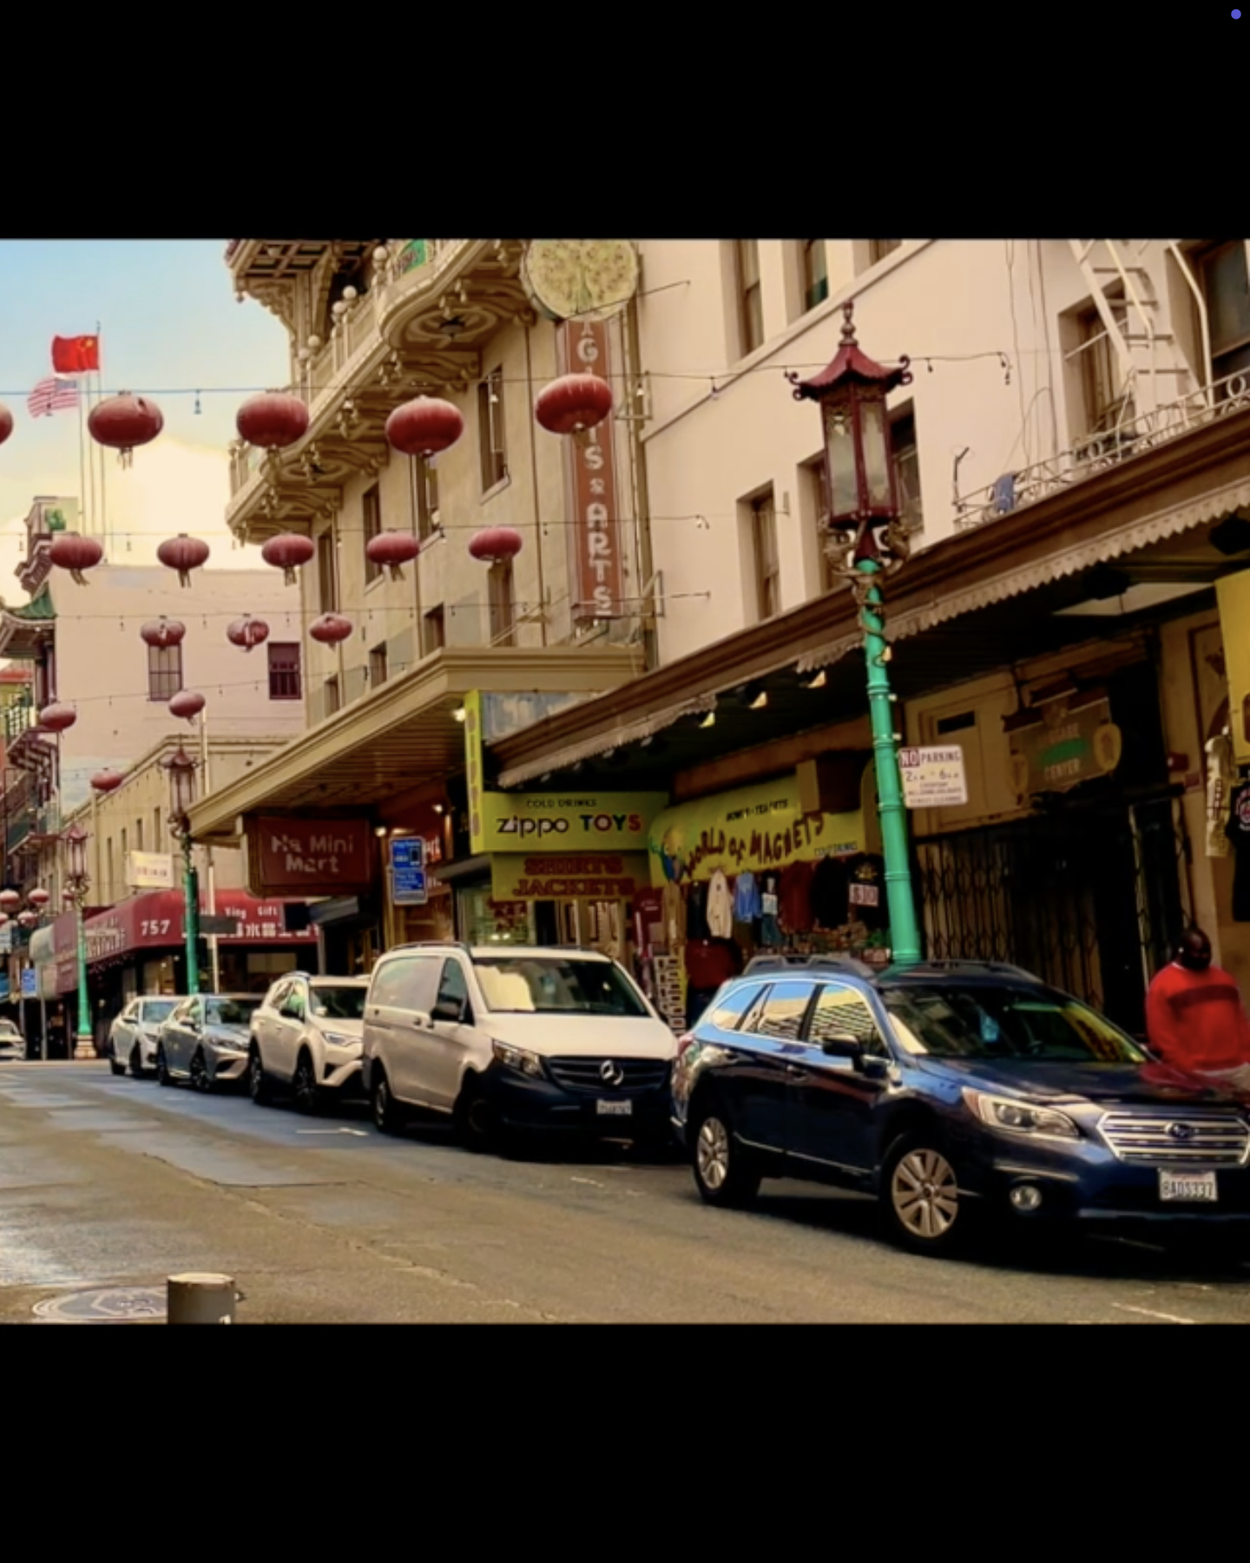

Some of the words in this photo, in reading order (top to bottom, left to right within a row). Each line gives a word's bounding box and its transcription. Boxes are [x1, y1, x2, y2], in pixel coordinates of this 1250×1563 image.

[586, 503, 611, 610] ARTS
[903, 751, 919, 767] NO
[921, 749, 961, 764] PARKING
[496, 814, 569, 838] zippo
[579, 813, 642, 832] TOYS
[309, 833, 354, 854] Mini
[750, 812, 825, 865] MAGNETS
[285, 853, 341, 873] Mart
[524, 856, 623, 876] SHIRTS
[512, 877, 636, 897] JACKETS
[225, 907, 247, 919] Ying
[141, 920, 170, 936] 757
